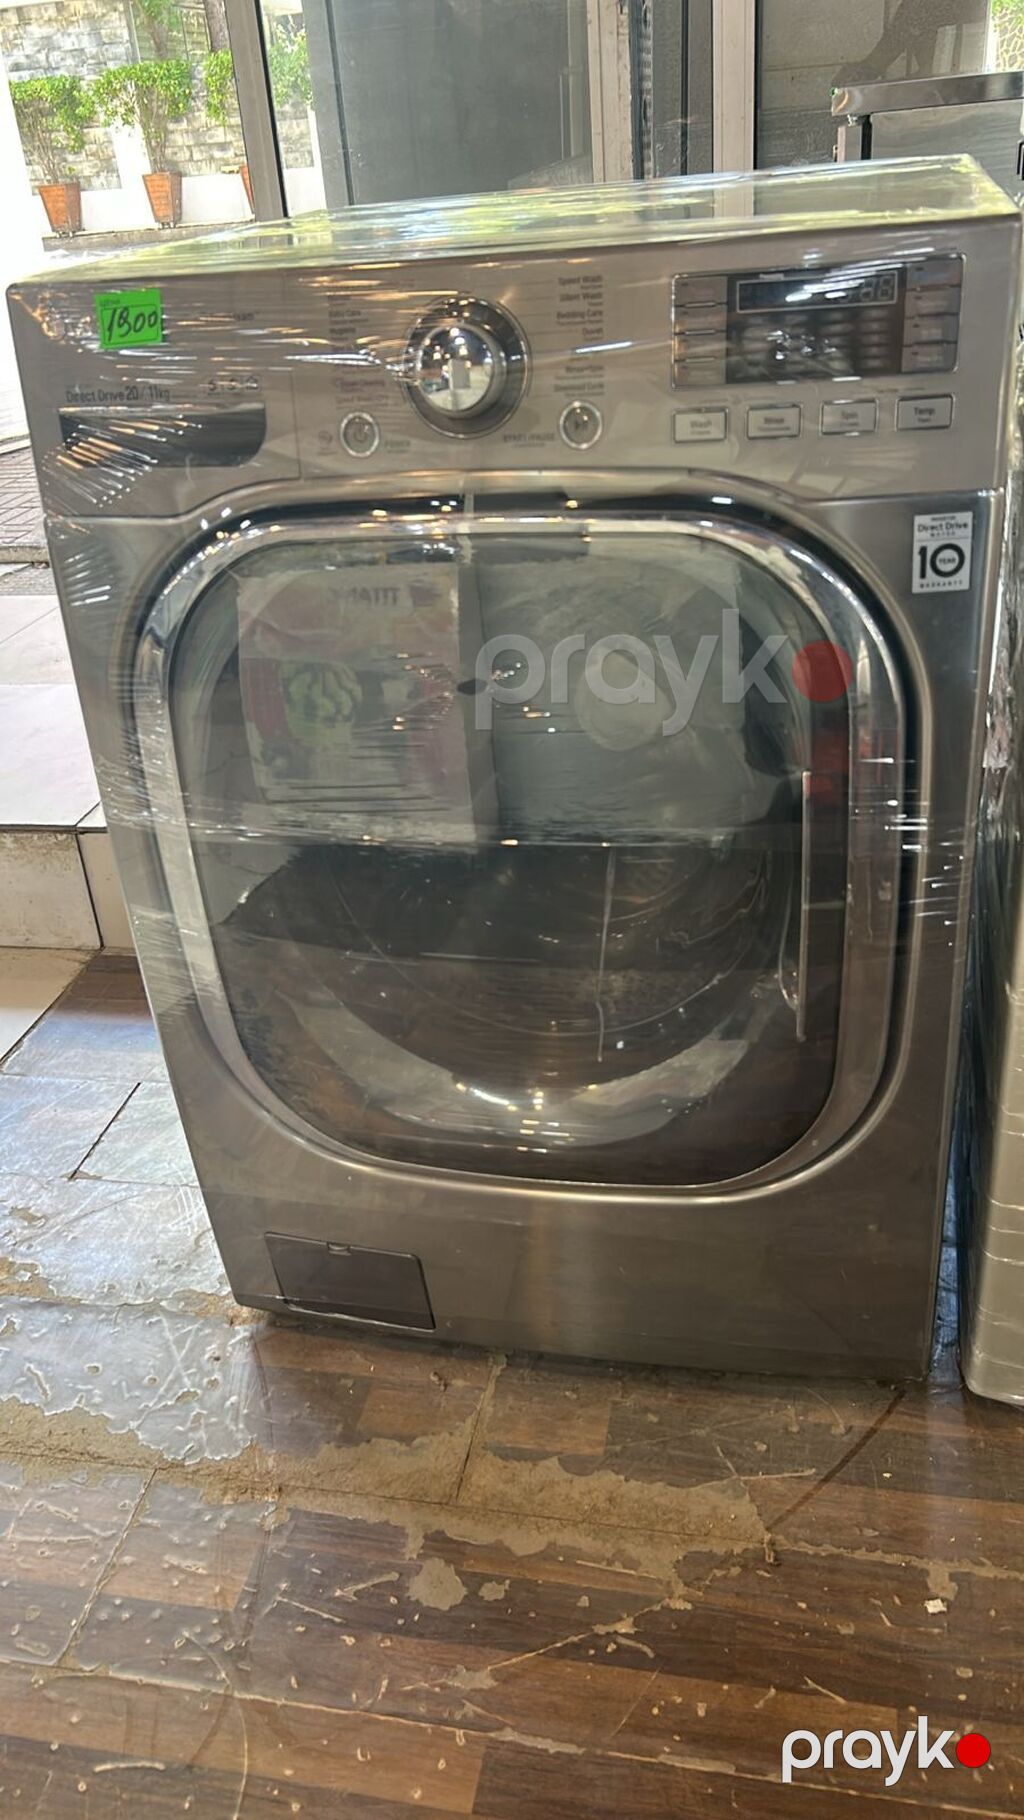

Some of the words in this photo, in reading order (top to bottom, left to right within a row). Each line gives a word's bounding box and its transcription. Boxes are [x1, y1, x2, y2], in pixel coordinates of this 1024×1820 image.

[917, 523, 944, 533] Direct
[945, 521, 968, 530] Drive
[918, 542, 966, 580] 10
